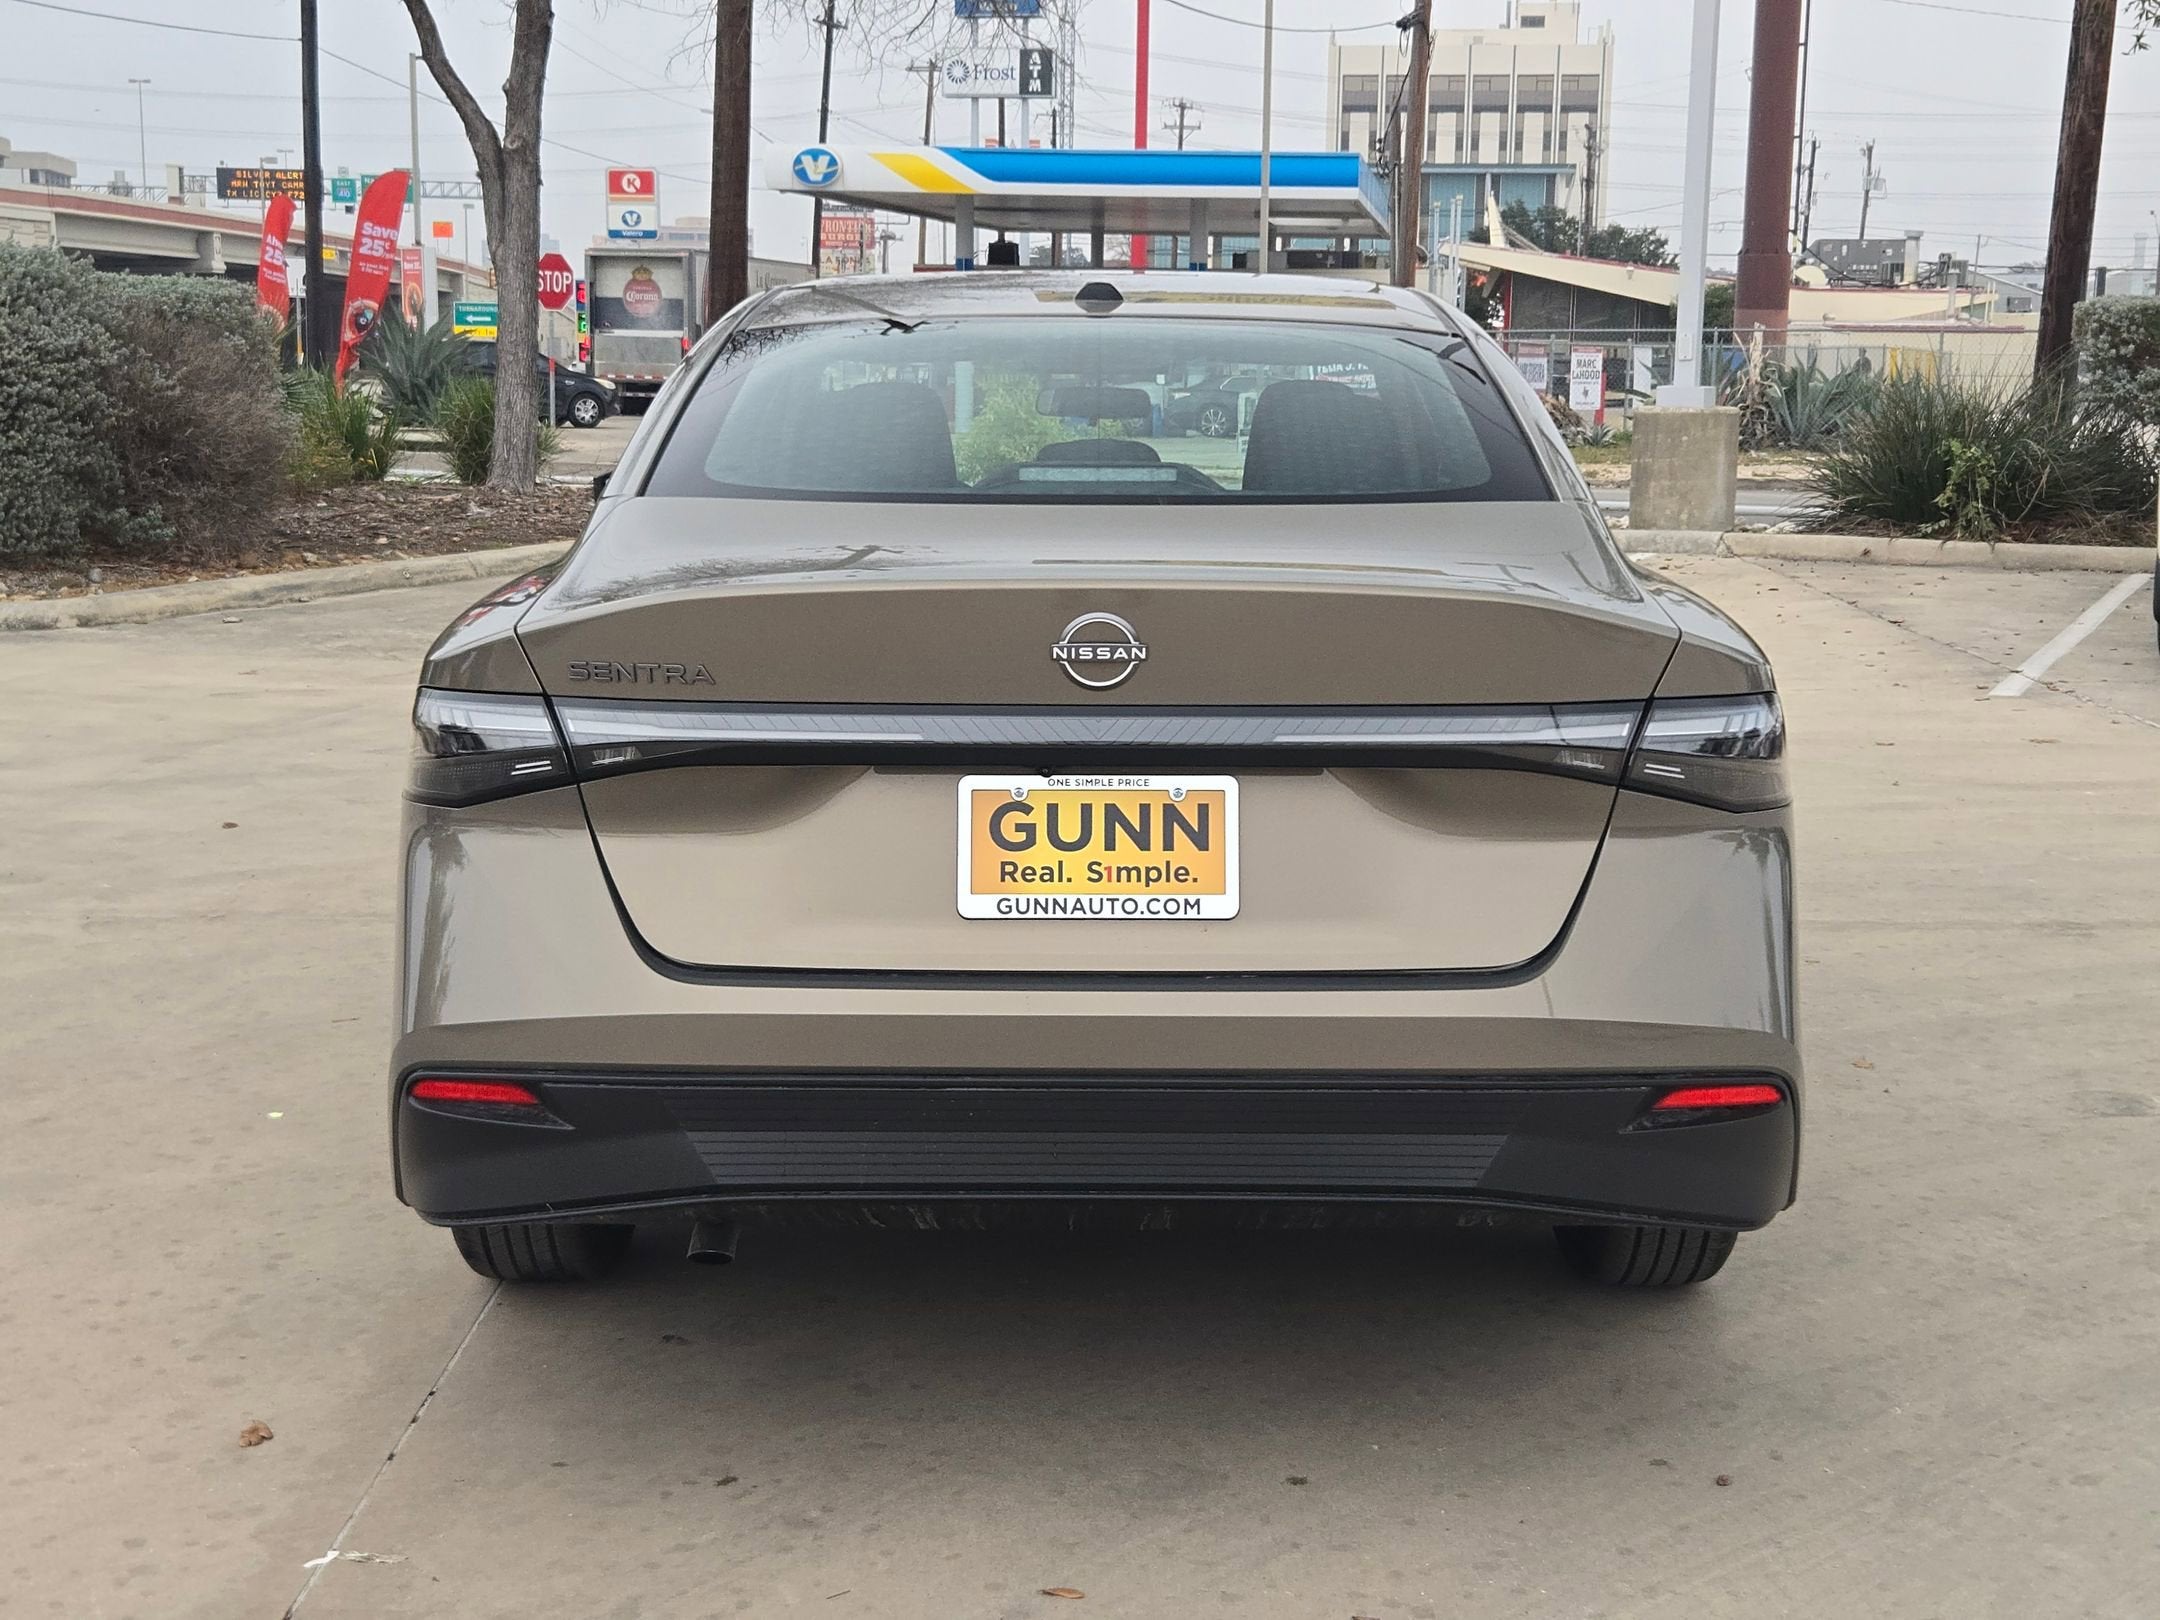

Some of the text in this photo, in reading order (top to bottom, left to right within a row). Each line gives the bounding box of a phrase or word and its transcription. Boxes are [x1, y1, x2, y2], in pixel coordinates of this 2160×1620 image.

[974, 63, 1017, 81] Frost
[1029, 51, 1042, 92] ATM
[235, 170, 271, 179] SILVR
[362, 222, 399, 240] Save
[538, 270, 572, 293] STOP
[625, 291, 660, 303] Corona
[1575, 359, 1597, 369] MARC
[1052, 646, 1147, 660] NISSAN
[568, 660, 716, 686] SENTRA
[1047, 778, 1150, 787] ONE SIMPLE PRICE
[989, 801, 1210, 852] GUNN
[1000, 860, 1072, 883] Real.
[996, 898, 1201, 915] GUNNAUTO.COM
